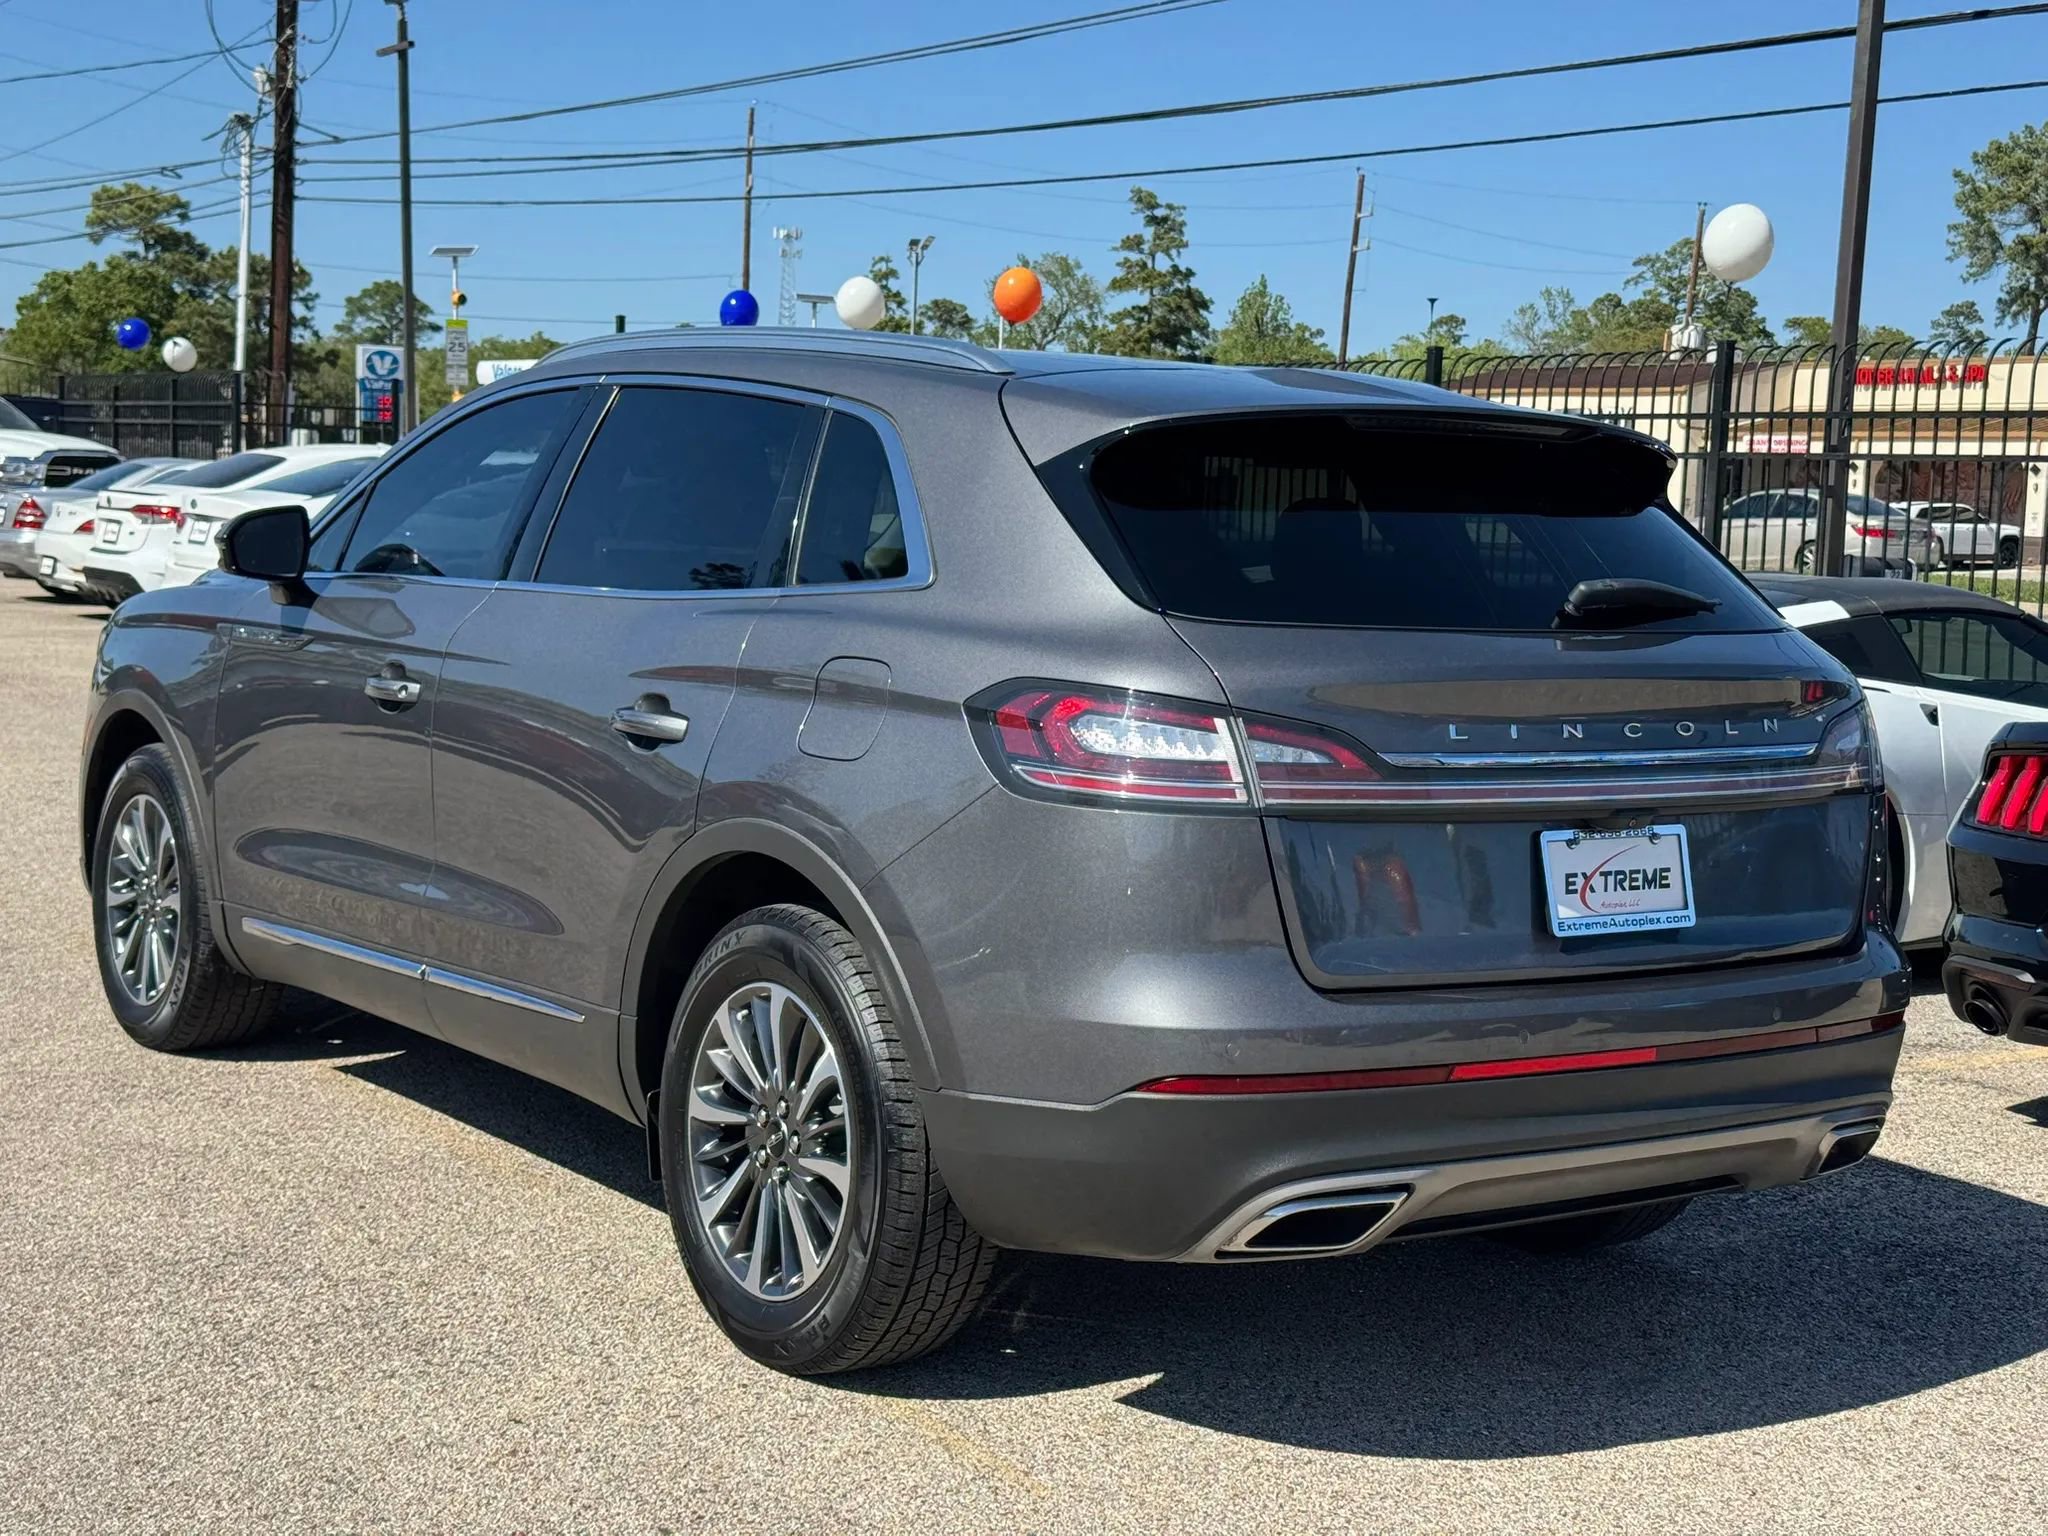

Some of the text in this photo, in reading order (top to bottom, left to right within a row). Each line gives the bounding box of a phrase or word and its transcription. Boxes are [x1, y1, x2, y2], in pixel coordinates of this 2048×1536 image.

[448, 342, 466, 352] 25
[1449, 718, 1779, 741] LINCOLN
[1564, 866, 1671, 896] EXTREME
[1557, 913, 1691, 932] ExtremeAutoplex.com
